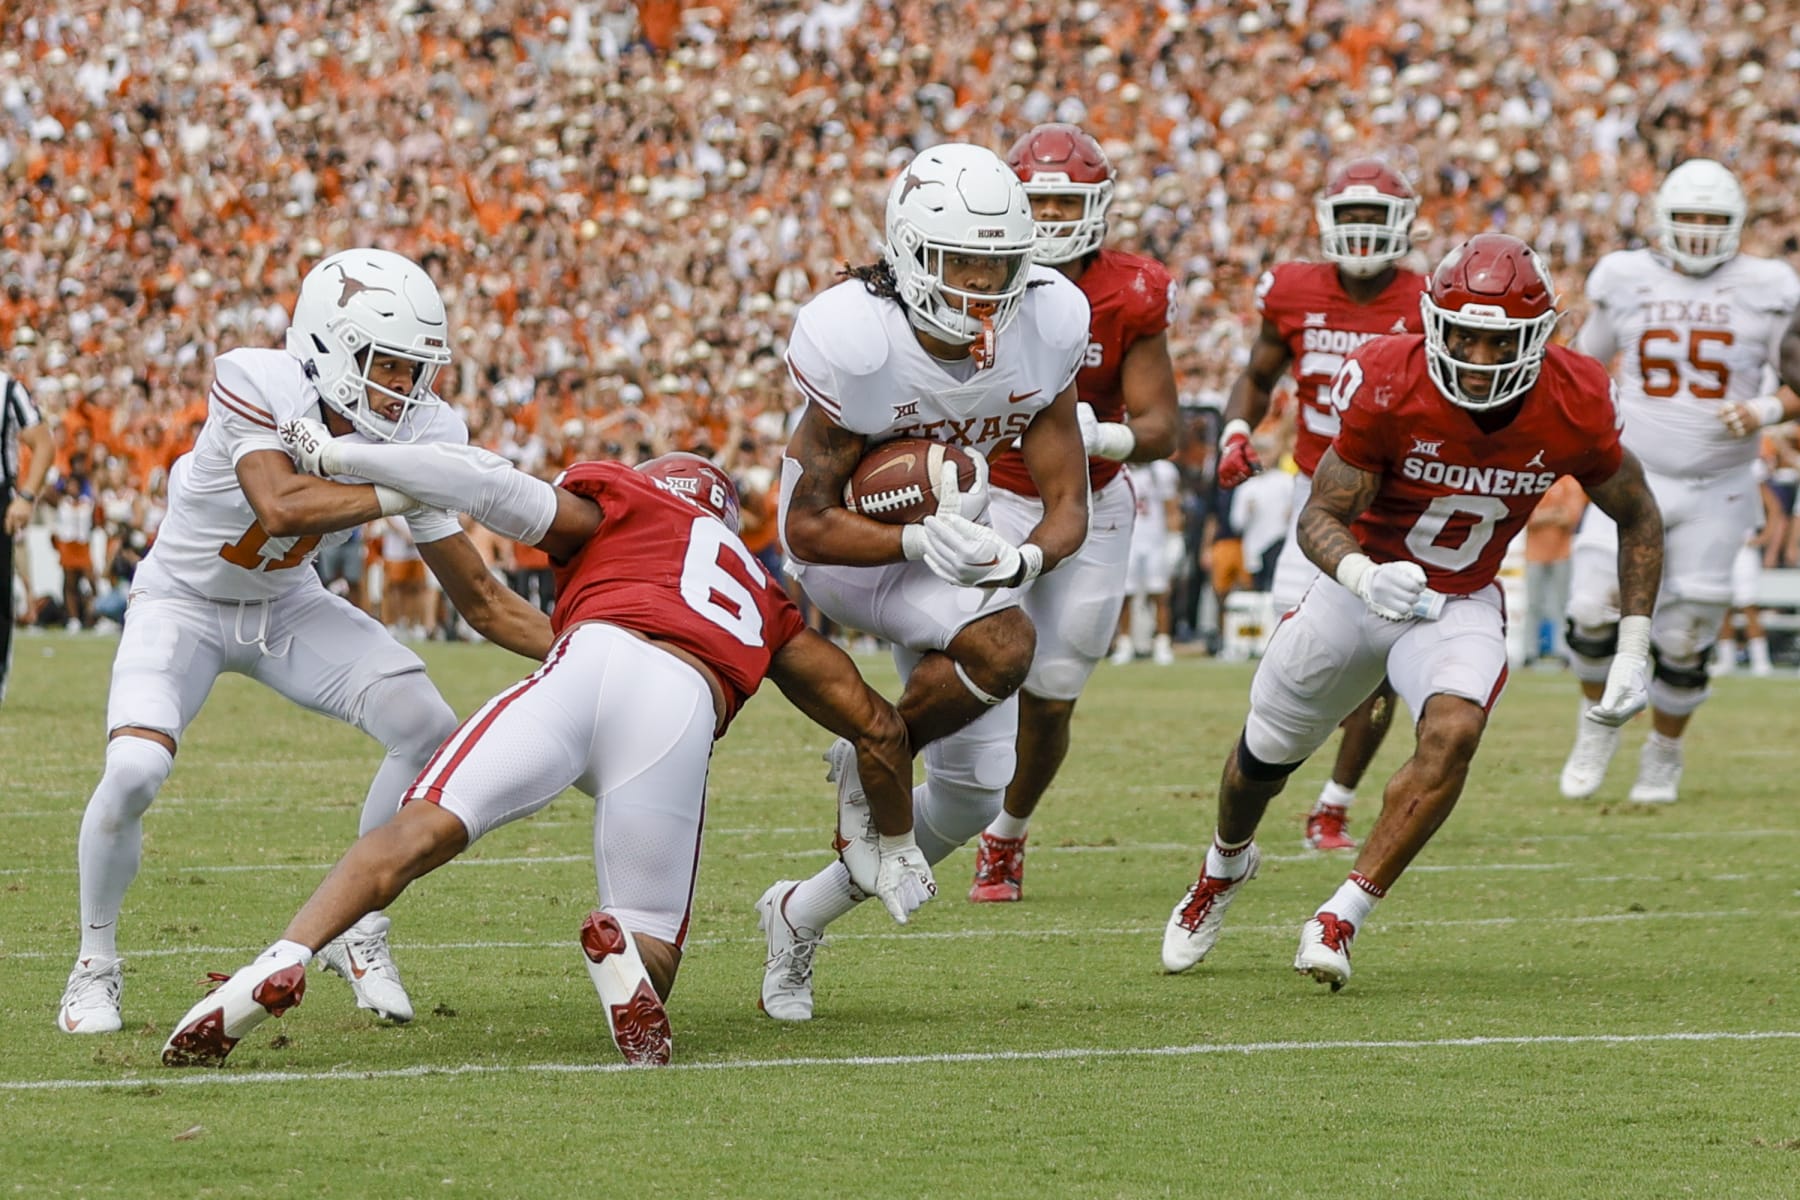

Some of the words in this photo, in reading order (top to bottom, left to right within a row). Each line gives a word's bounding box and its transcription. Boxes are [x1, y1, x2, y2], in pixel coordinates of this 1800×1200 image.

[1637, 301, 1731, 324] TEXAS
[1303, 328, 1384, 354] SOON
[1638, 329, 1735, 400] 65
[1331, 358, 1364, 412] 0
[893, 412, 1031, 447] TEXAS
[1408, 437, 1445, 457] XII
[669, 478, 696, 492] XII
[1402, 457, 1556, 496] SOONERS
[709, 483, 726, 510] 6
[1403, 494, 1511, 573] 0
[679, 515, 768, 649] 6
